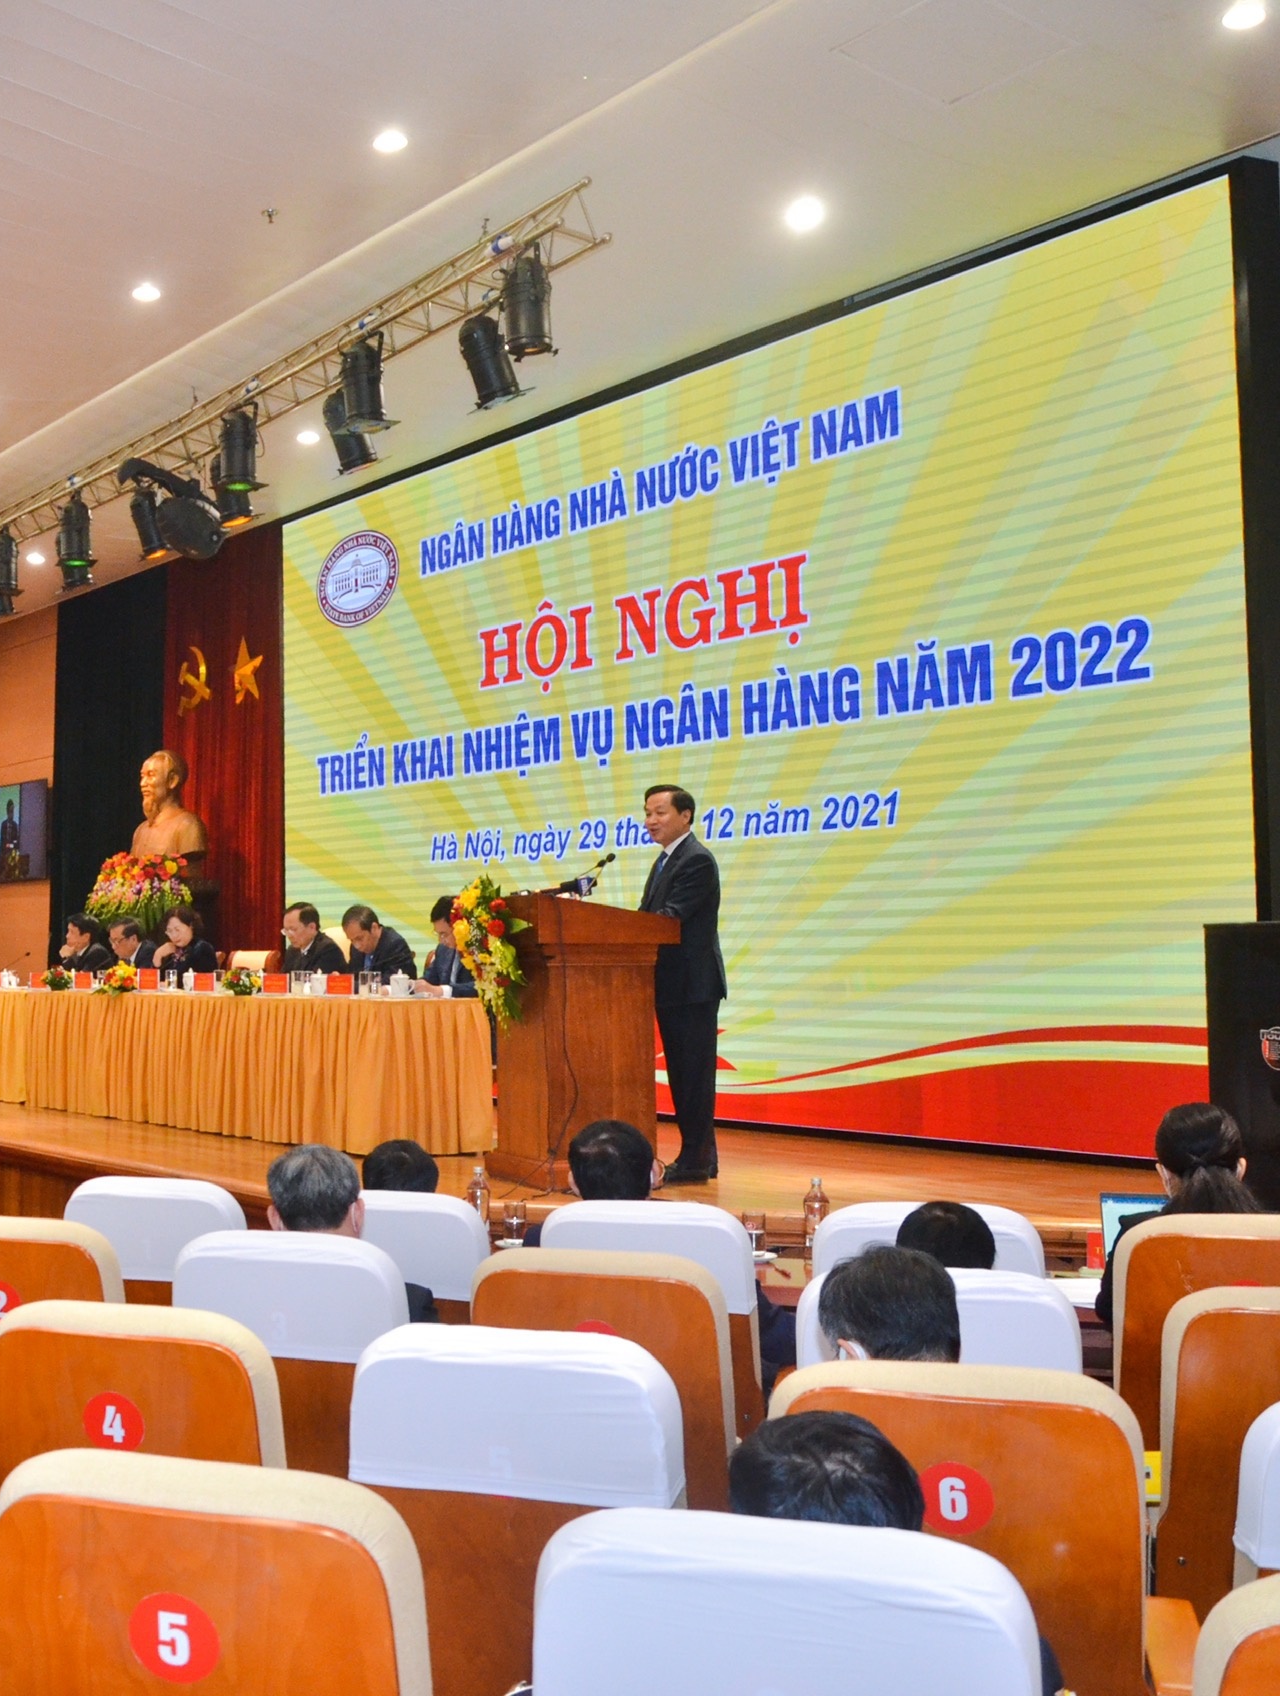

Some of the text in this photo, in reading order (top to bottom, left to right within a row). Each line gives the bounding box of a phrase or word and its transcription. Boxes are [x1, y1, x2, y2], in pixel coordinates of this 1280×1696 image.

[422, 390, 900, 575] NGÂN HÀNG NHÀ NƯỚC VIỆT NAM
[481, 556, 807, 691] HỘI NGHỊ
[317, 619, 1151, 794] TRIỂN KHAI NHIỆM VỤ NGÂN HÀNG NĂM 2022
[431, 833, 458, 862] Hà
[464, 829, 506, 865] Nội,
[513, 823, 571, 862] ngày
[579, 819, 607, 850] 29
[703, 808, 735, 840] 12
[744, 803, 810, 836] năm
[822, 790, 899, 831] 2021
[103, 1405, 125, 1443] 4
[938, 1477, 967, 1521] 6
[157, 1610, 190, 1666] 5
